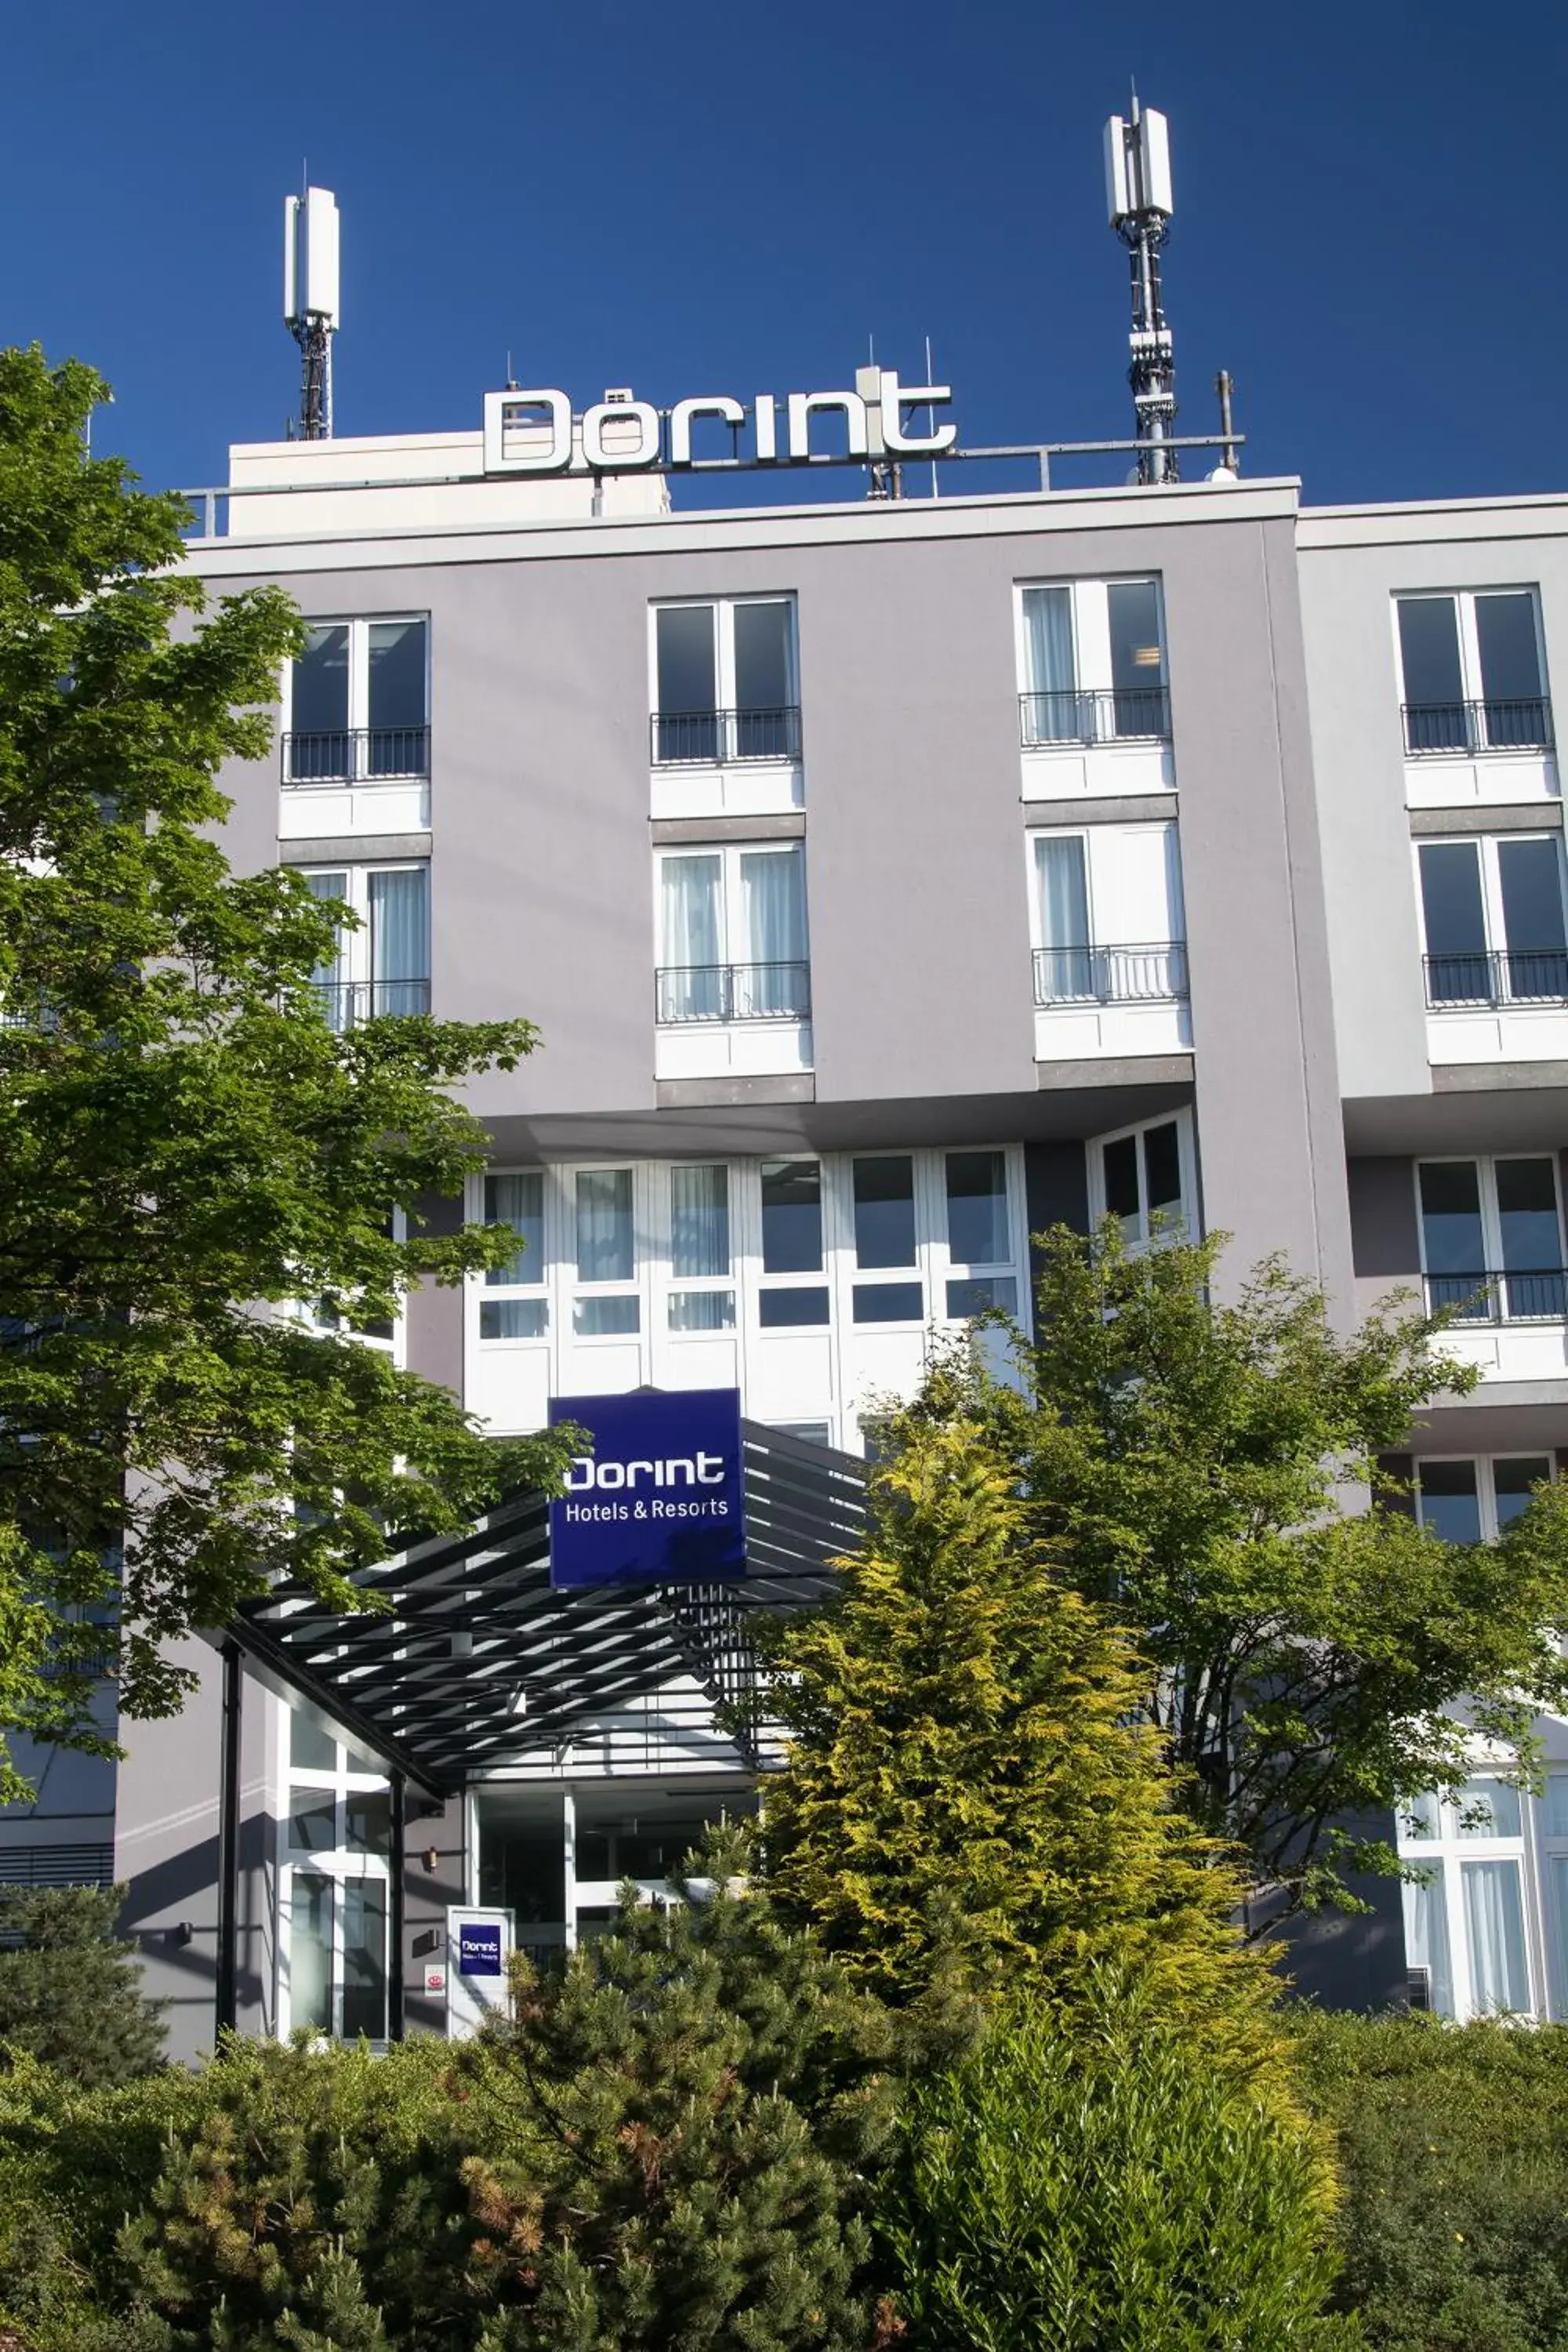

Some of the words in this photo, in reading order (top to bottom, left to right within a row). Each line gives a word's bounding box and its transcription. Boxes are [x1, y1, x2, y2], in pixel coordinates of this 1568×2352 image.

[483, 369, 956, 472] Dorint
[562, 1451, 725, 1490] Dorint
[566, 1501, 628, 1522] Hotels
[633, 1500, 648, 1519] &
[652, 1498, 729, 1519] Resorts
